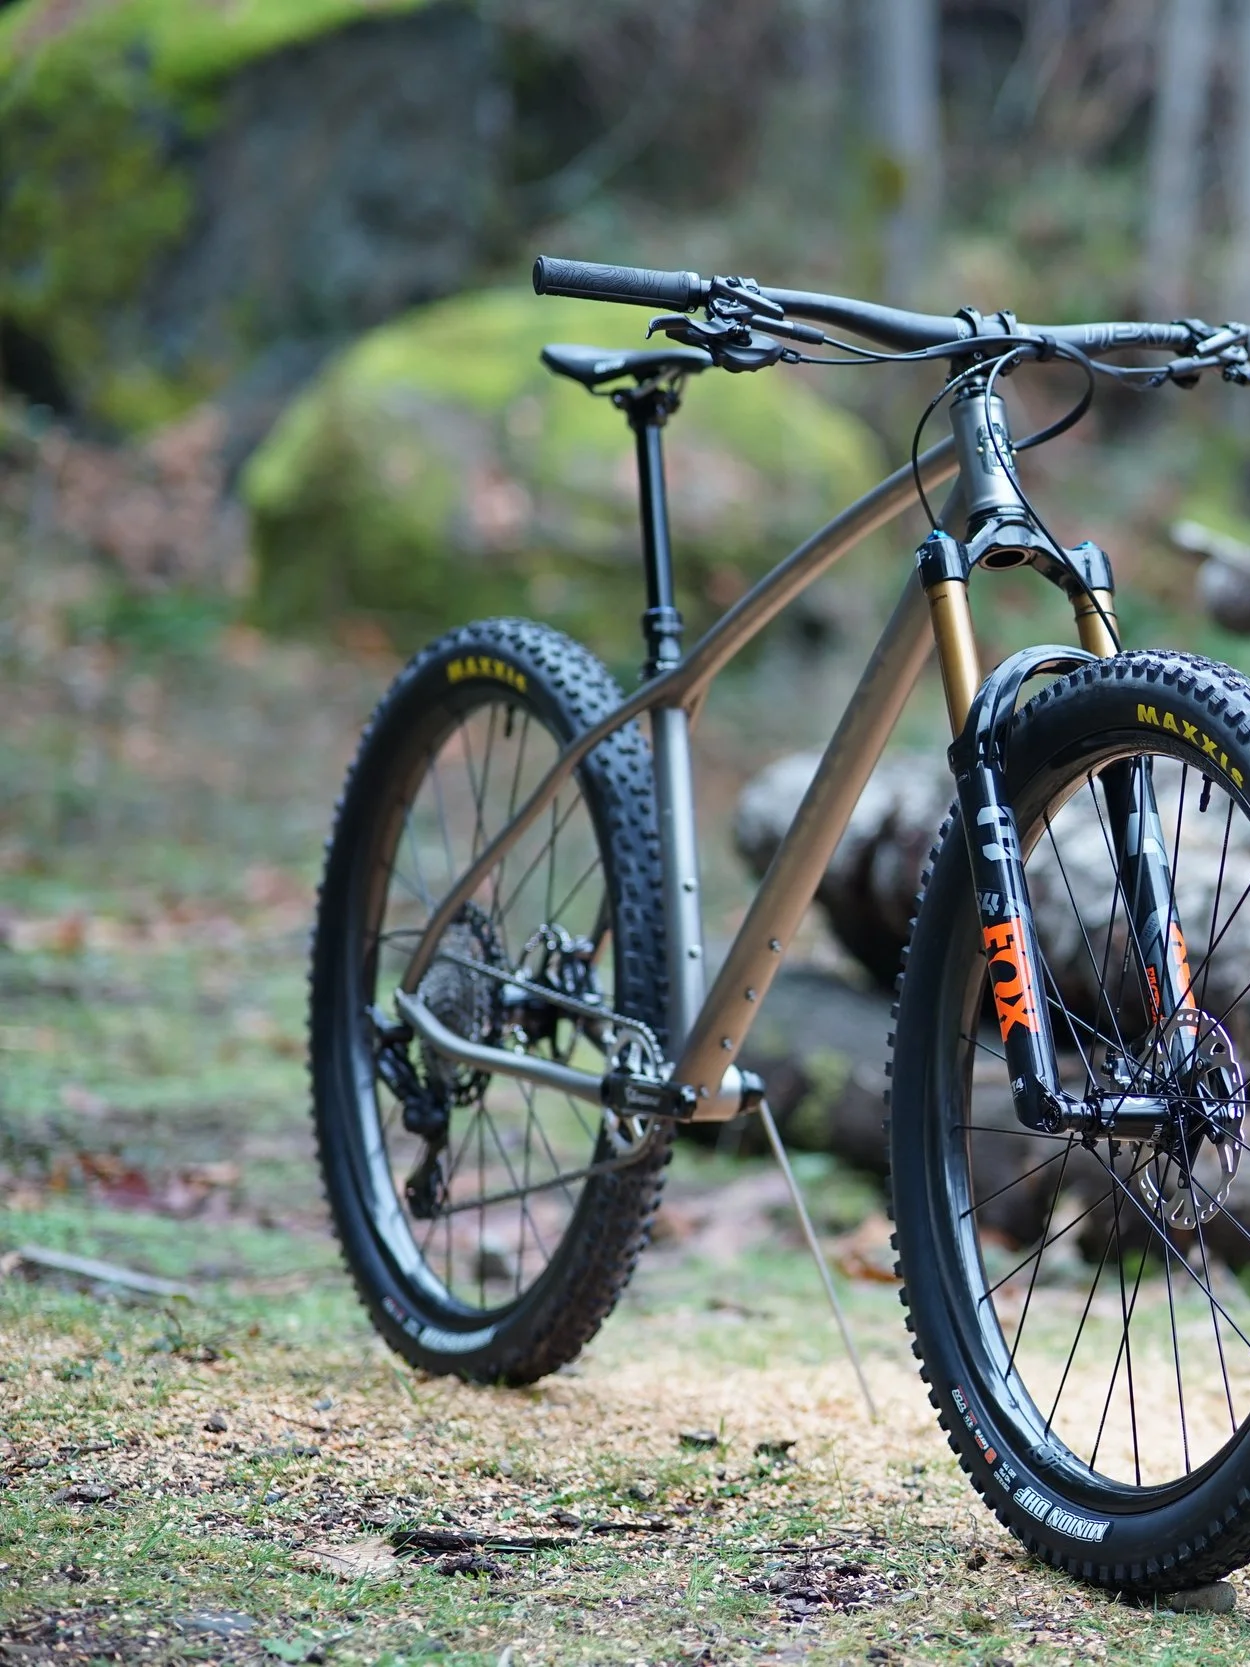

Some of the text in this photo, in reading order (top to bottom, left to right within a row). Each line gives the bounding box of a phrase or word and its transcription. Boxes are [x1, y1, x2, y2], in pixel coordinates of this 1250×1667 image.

[1137, 703, 1244, 789] MAXXIS
[983, 917, 1039, 1043] FOX
[1013, 1486, 1110, 1542] MINION DHF
